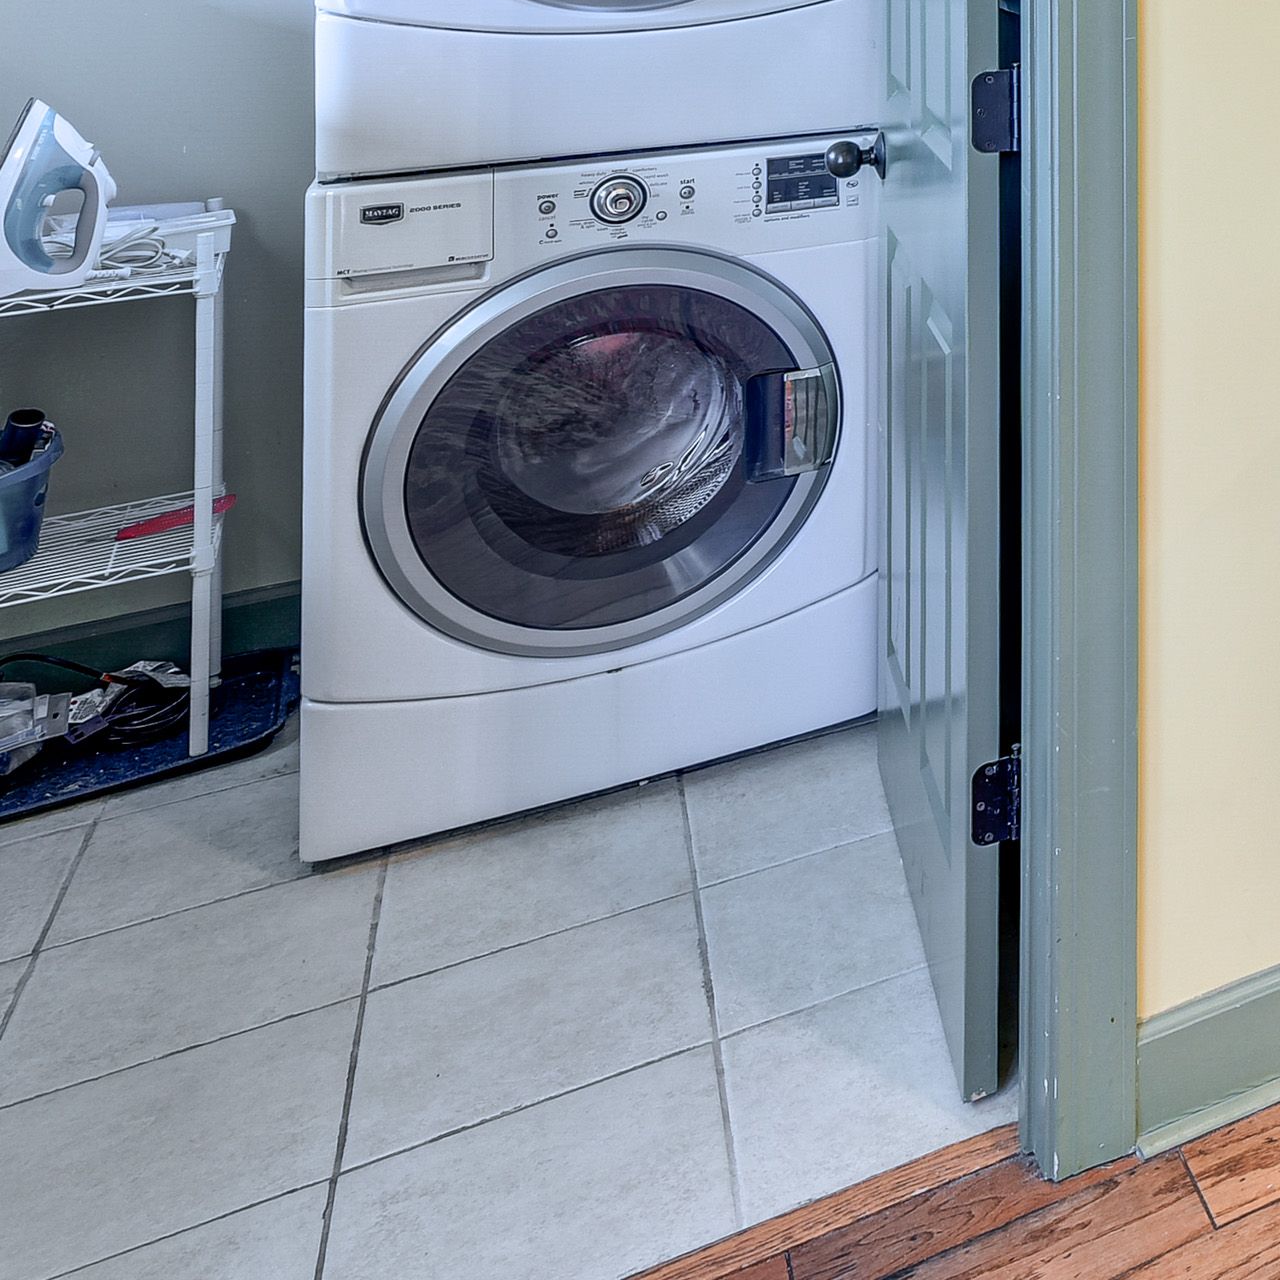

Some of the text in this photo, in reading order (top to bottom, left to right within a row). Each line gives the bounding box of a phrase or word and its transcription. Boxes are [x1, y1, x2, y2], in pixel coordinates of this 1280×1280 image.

[537, 192, 559, 201] power
[432, 202, 462, 211] SERIES
[364, 207, 400, 218] MAYTAG
